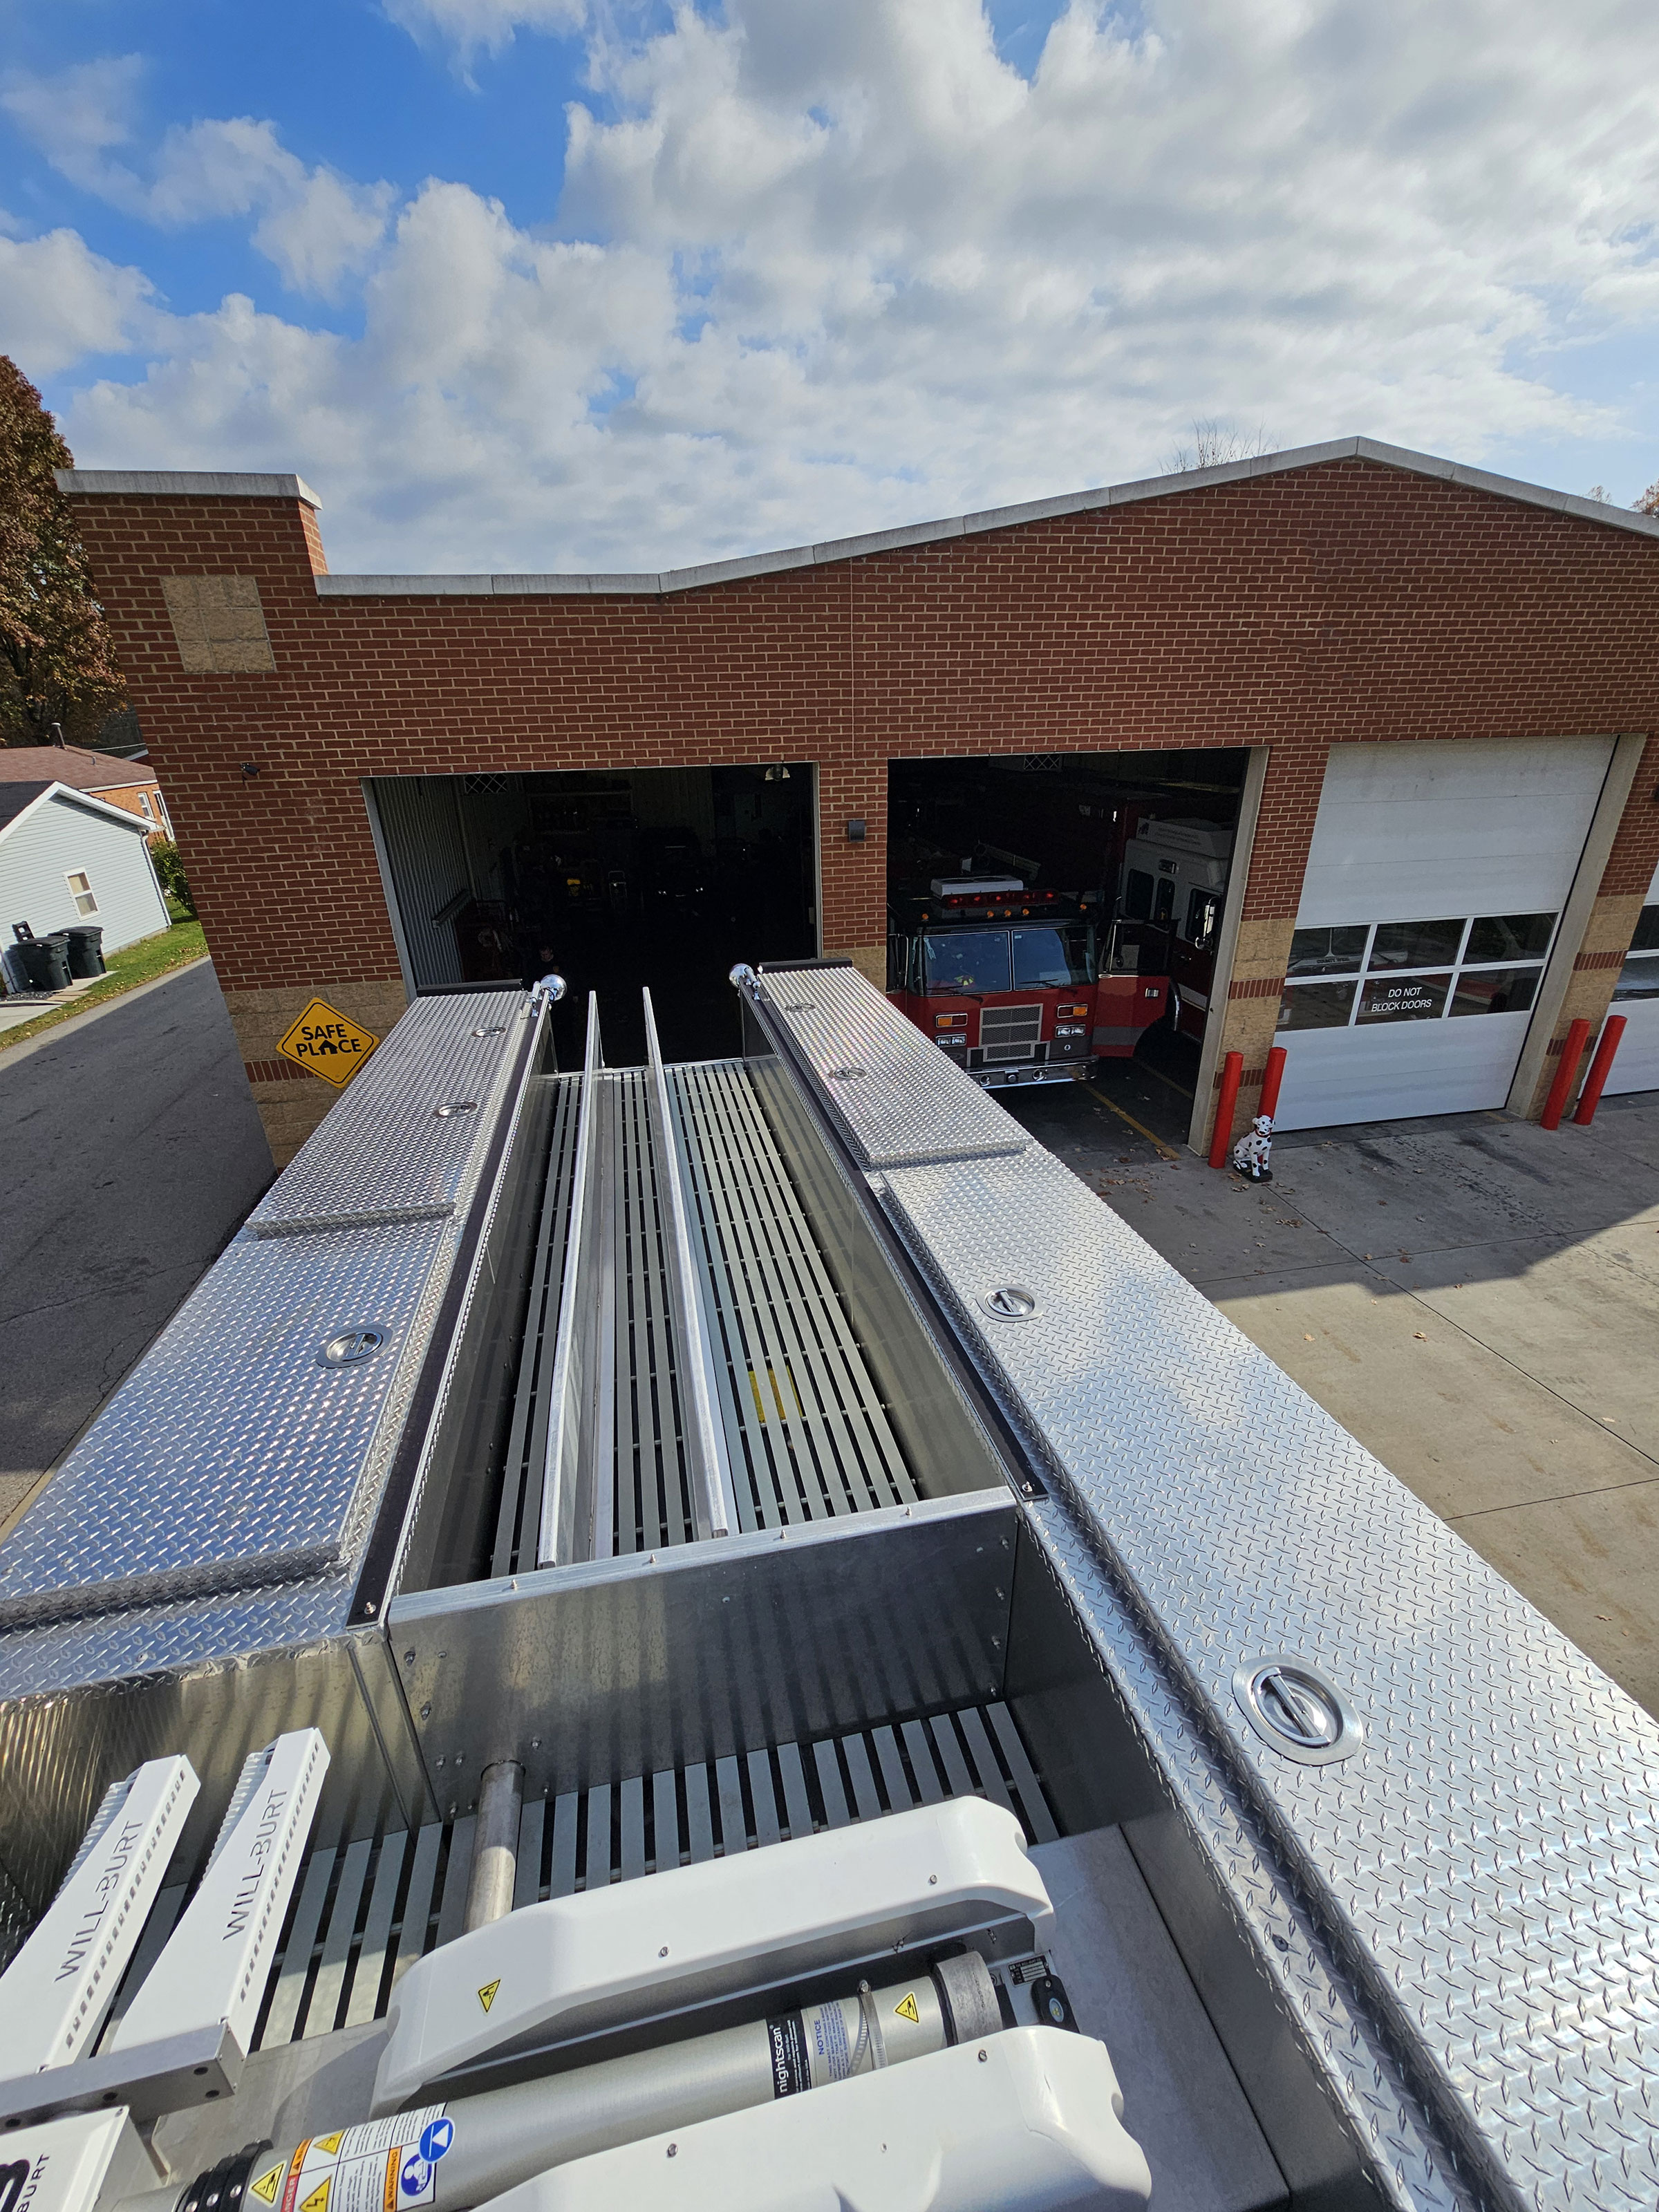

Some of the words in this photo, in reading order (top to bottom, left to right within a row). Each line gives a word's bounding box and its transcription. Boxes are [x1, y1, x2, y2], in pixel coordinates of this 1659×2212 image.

[1371, 1002, 1401, 1012] BLOCK
[1401, 999, 1432, 1009] DOORS
[1388, 988, 1402, 997] DO
[1403, 987, 1423, 996] NOT
[301, 1024, 347, 1040] SAFE
[223, 1789, 288, 1941] WILL-BURT
[54, 1820, 144, 1983] WILL-BURT
[814, 2019, 825, 2055] NOTICE
[773, 2026, 789, 2093] nightscan
[388, 2151, 398, 2198] WARNING
